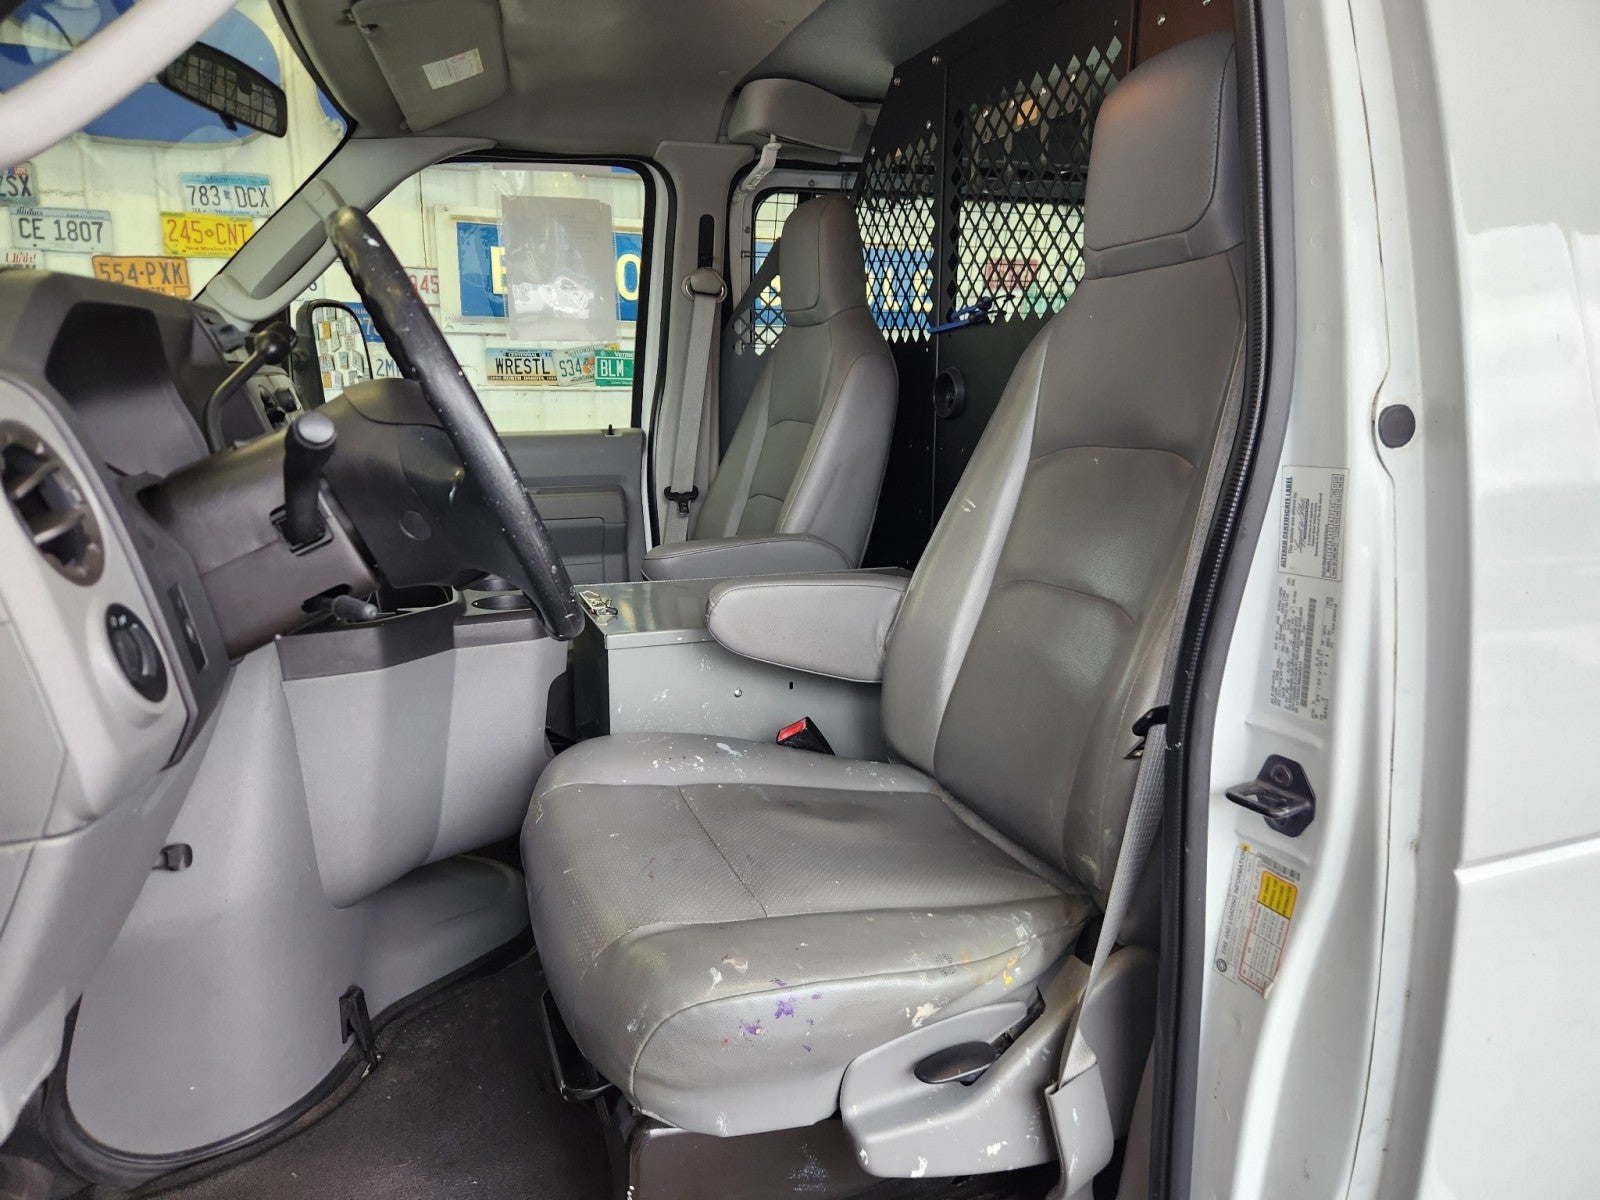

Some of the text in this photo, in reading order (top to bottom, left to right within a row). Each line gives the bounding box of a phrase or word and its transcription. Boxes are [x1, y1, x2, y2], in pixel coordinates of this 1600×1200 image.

[0, 175, 31, 197] SX
[186, 185, 270, 208] 783 DCX
[18, 217, 103, 243] CE 1807
[167, 219, 247, 246] 245 CNT
[495, 357, 550, 375] WRESTL
